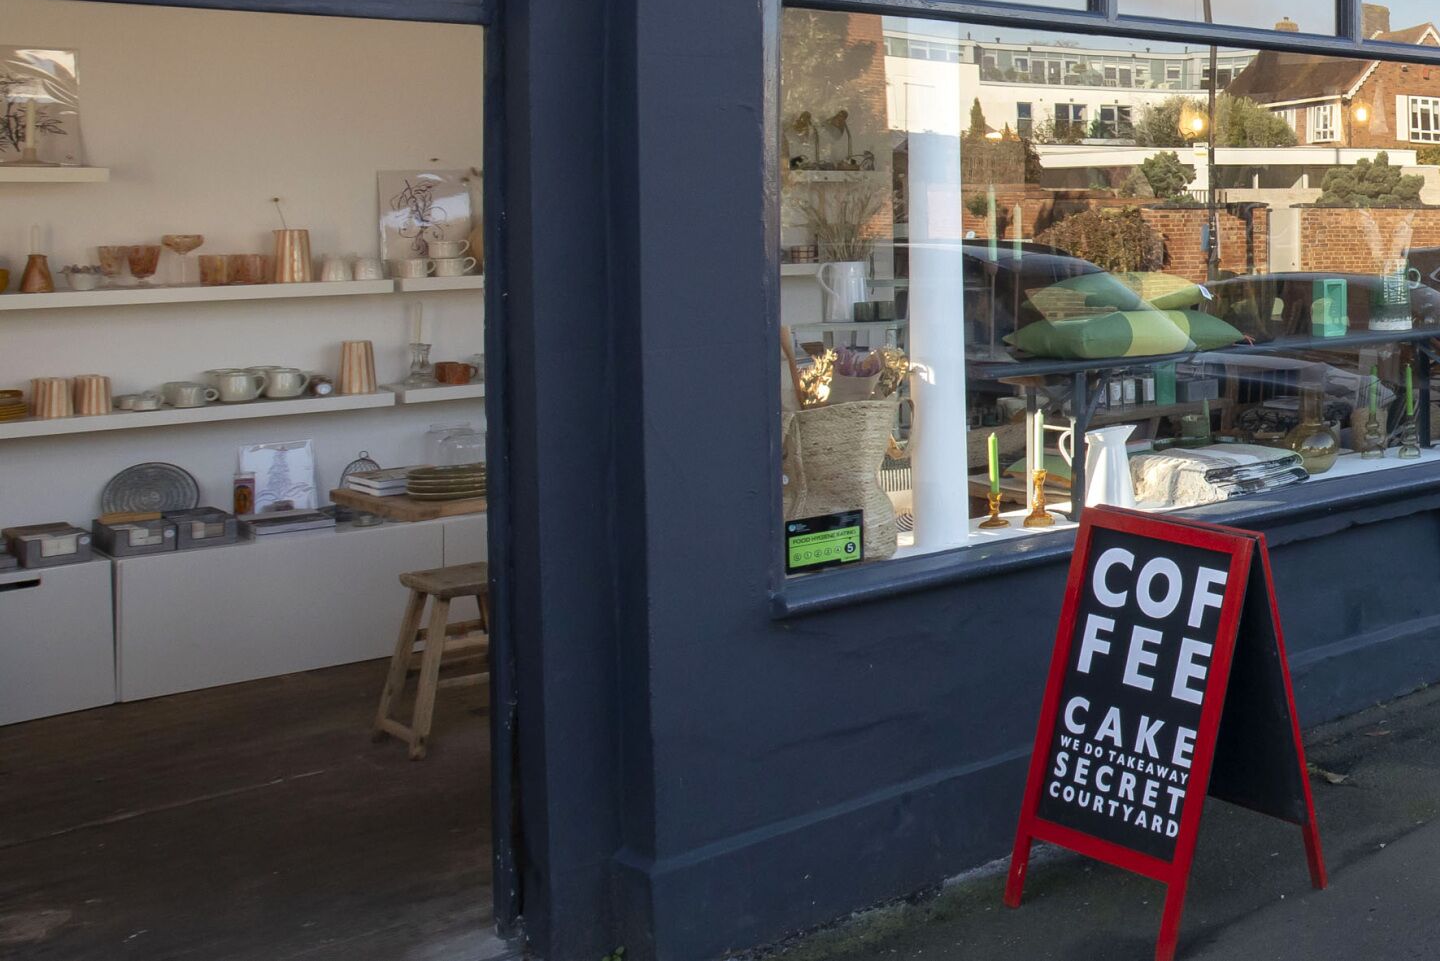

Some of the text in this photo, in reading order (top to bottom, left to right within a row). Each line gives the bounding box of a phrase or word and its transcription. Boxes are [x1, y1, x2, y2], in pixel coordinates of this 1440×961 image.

[1092, 547, 1228, 628] COF
[1076, 613, 1213, 705] FEE
[1060, 734, 1189, 785] WE DO TAKEAWAY
[1064, 696, 1197, 769] CAKE
[1049, 781, 1179, 837] COURTYARD
[1053, 751, 1186, 815] SECRET
